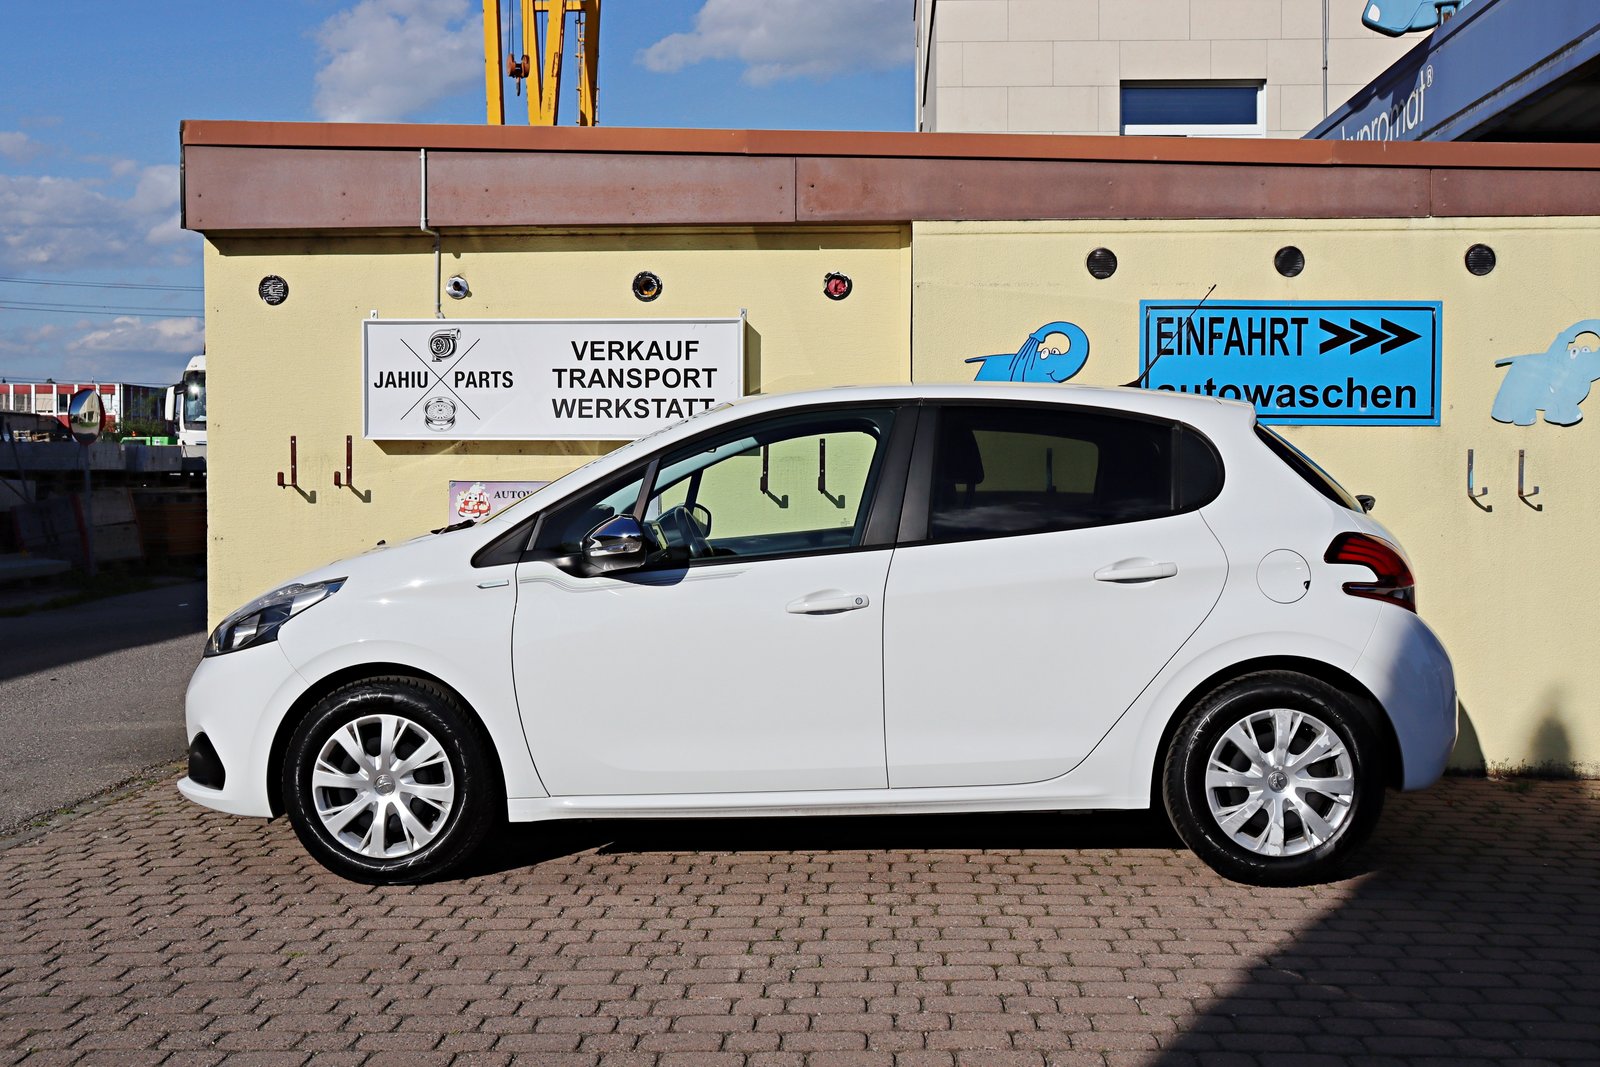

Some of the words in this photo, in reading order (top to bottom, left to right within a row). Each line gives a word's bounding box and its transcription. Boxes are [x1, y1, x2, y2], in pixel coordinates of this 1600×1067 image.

[1156, 316, 1309, 356] EINFAHRT
[571, 340, 700, 361] VERKAUF
[373, 371, 429, 388] JAHIU
[454, 370, 514, 388] PARTS
[552, 368, 718, 389] TRANSPORT
[551, 398, 716, 419] WERKSTATT
